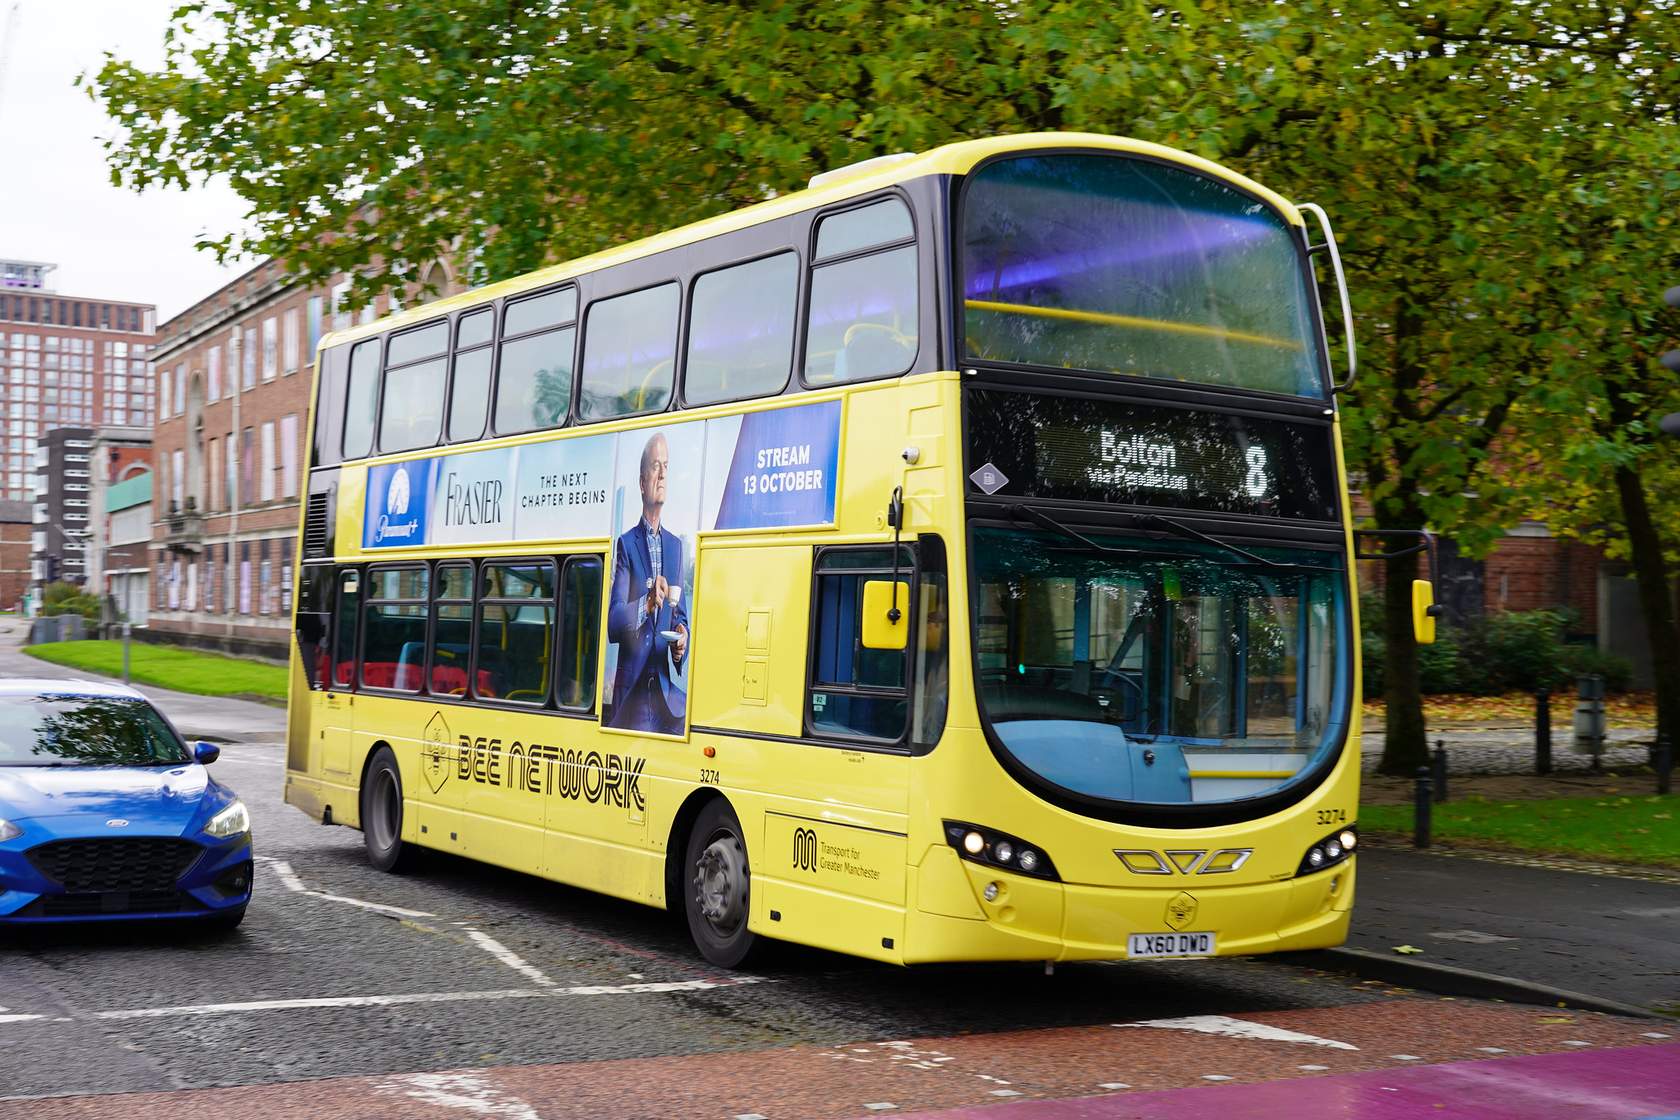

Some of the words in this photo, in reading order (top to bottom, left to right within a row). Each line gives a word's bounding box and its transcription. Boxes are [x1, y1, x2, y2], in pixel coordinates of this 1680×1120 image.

[757, 445, 810, 469] STREAM
[1100, 431, 1176, 467] Bolton
[540, 475, 557, 488] THE
[561, 472, 588, 486] NEXT
[743, 477, 756, 495] 13
[760, 469, 823, 493] OCTOBER
[1245, 445, 1268, 497] 8
[445, 472, 503, 526] FRASIER
[521, 493, 565, 508] CHAPTER
[568, 490, 606, 505] BEGINS
[457, 735, 502, 786] BEE
[507, 741, 647, 811] NETWORK
[700, 768, 720, 784] 3274
[1316, 809, 1346, 825] 3274
[820, 841, 851, 860] Transport
[851, 847, 860, 860] for
[819, 856, 843, 873] Greater
[844, 861, 880, 881] Manchester
[1134, 936, 1174, 954] LX60
[1179, 934, 1209, 953] DWD
